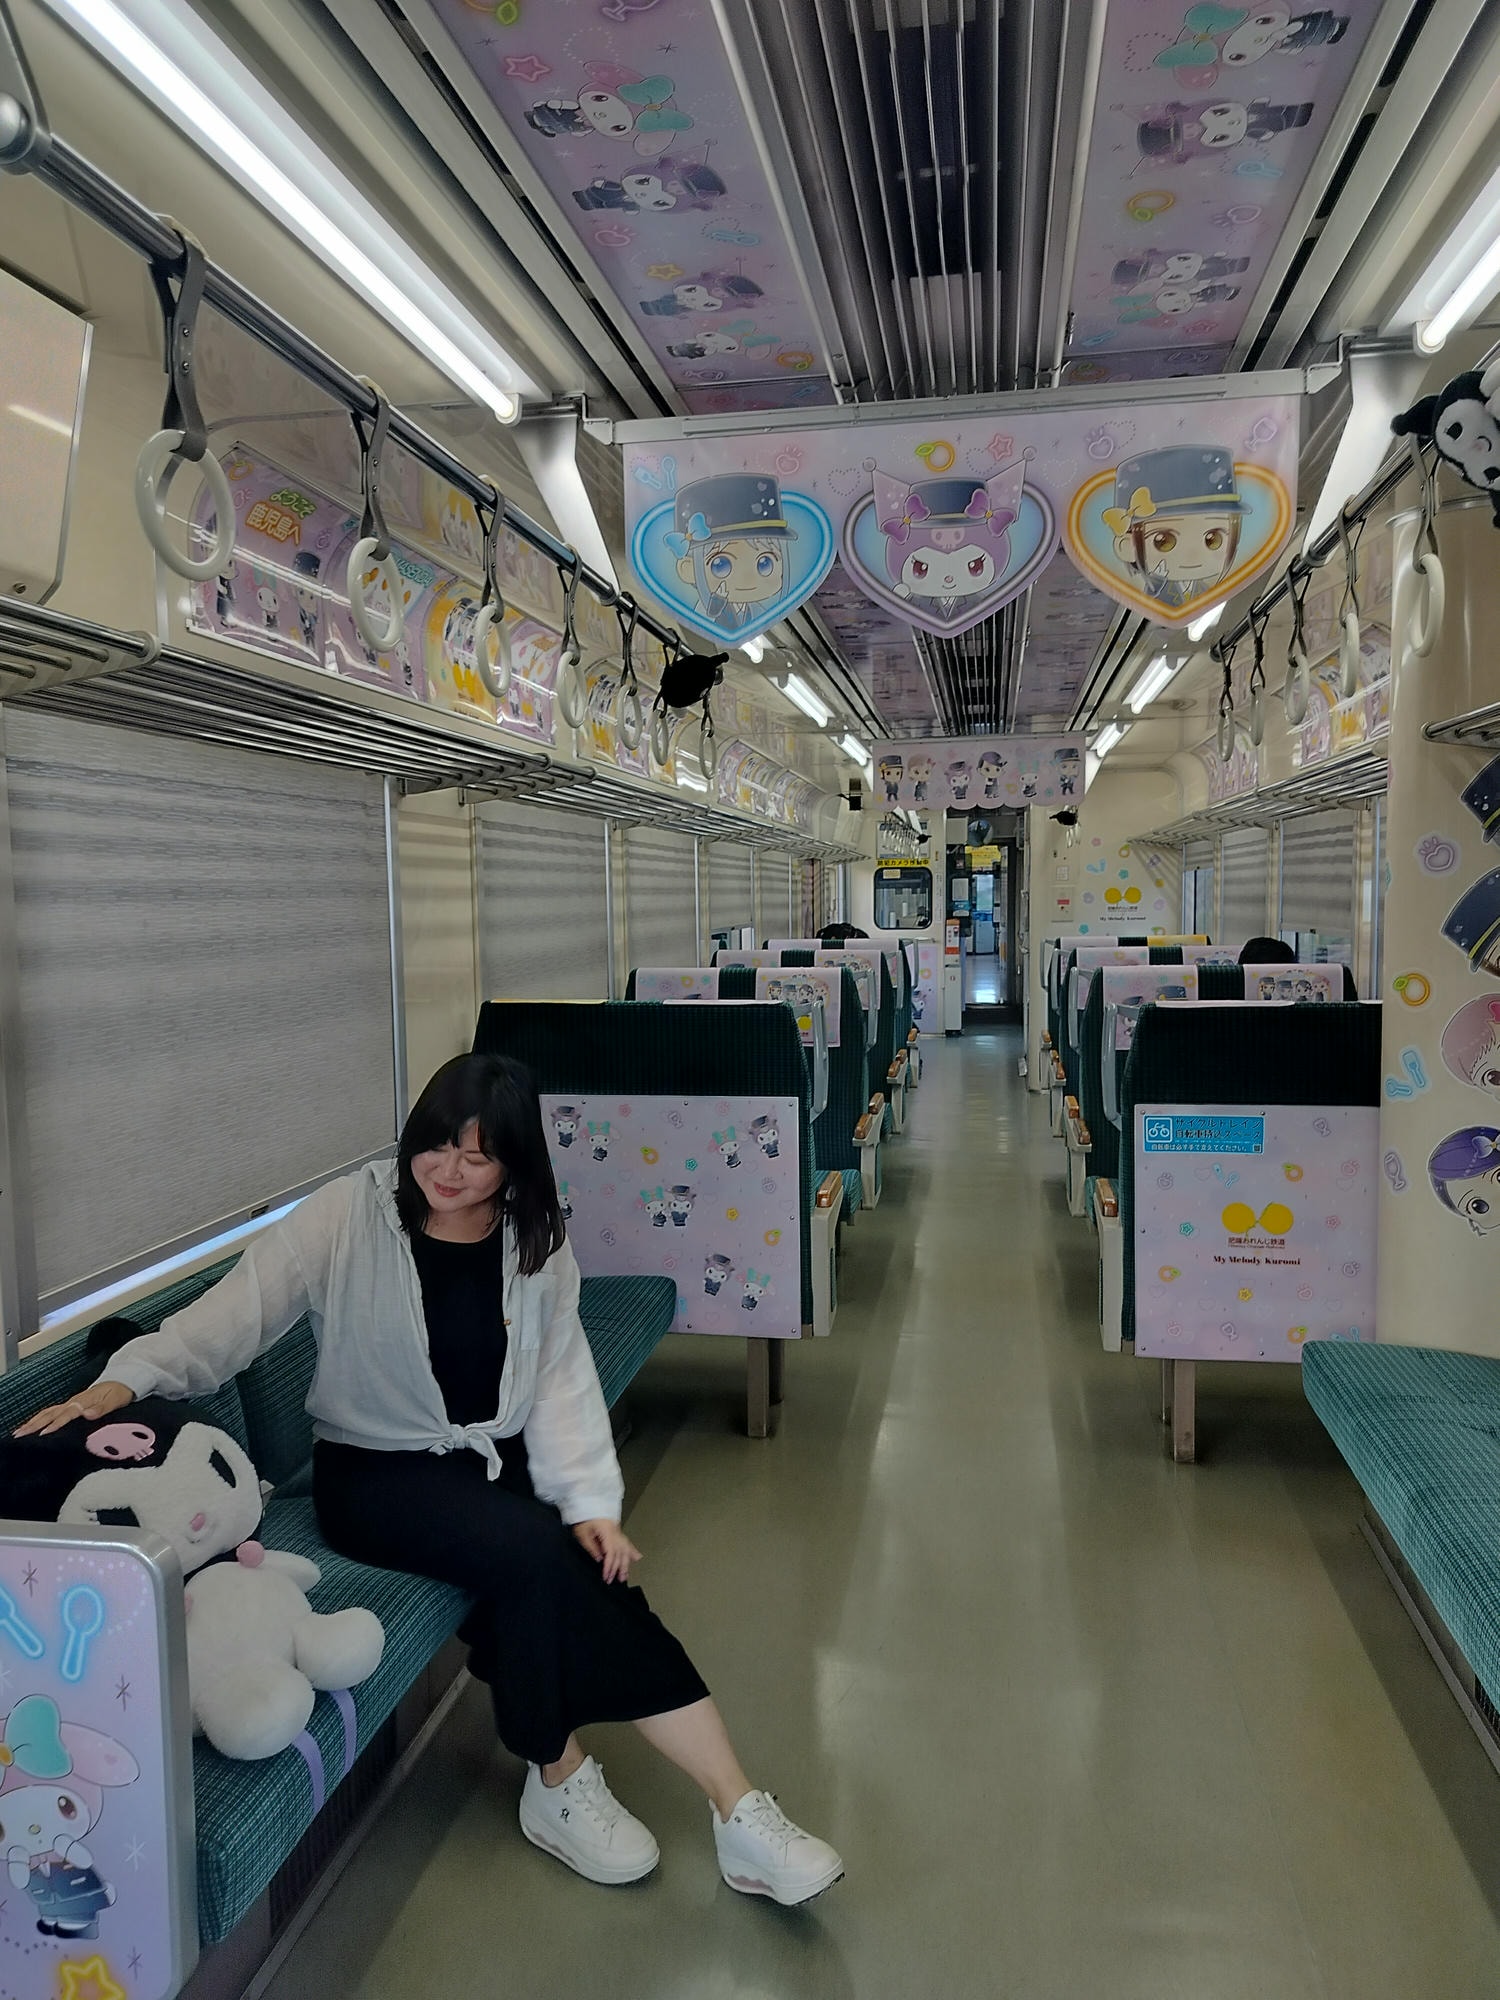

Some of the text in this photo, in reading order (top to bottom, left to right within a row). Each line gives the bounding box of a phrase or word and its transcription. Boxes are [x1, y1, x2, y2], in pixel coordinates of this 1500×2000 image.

[270, 488, 316, 519] ようこそ
[246, 502, 300, 545] 鹿児島へ
[1175, 1118, 1262, 1129] サイクルトレイン
[1213, 1255, 1301, 1266] My Melody Kuromi
